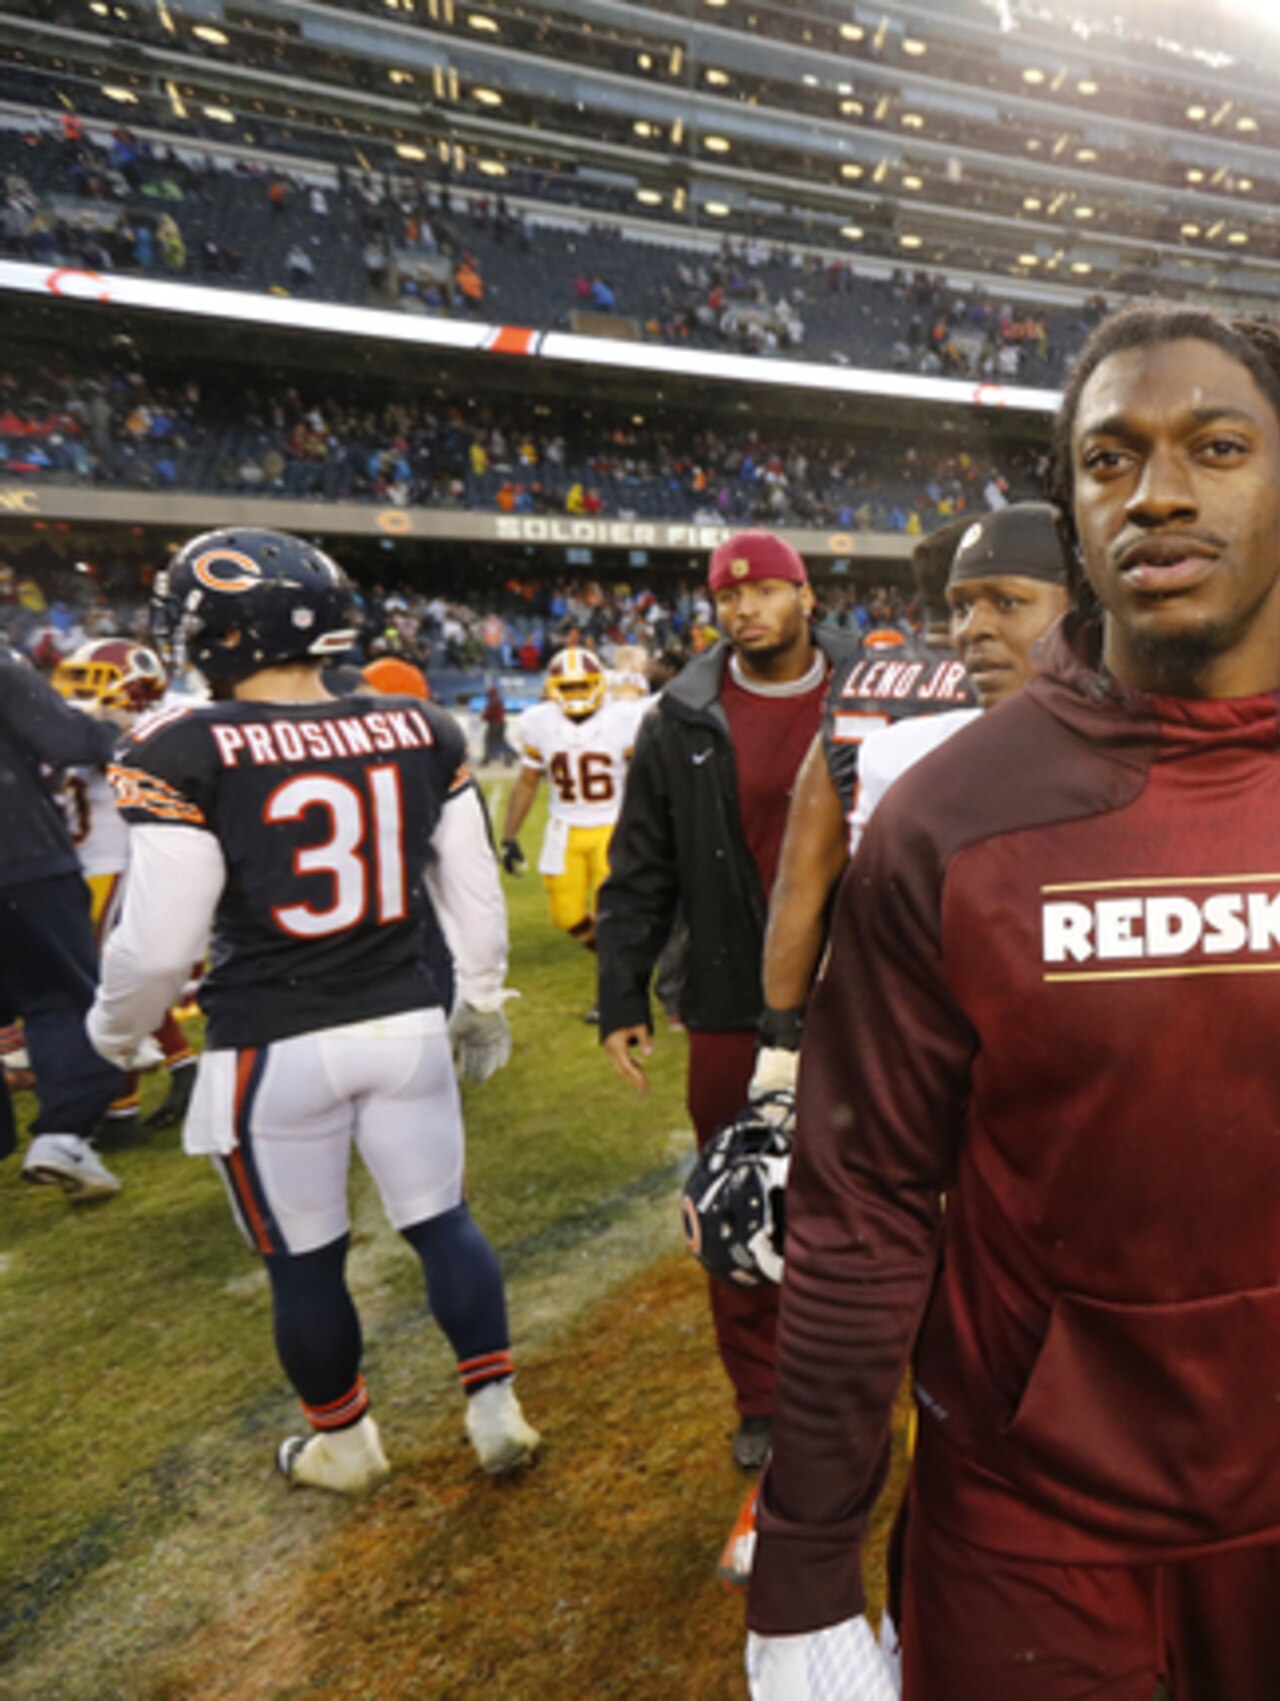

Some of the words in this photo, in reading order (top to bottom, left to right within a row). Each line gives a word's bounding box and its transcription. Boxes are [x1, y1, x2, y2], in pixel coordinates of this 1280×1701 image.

[496, 517, 655, 545] SOLDIER
[667, 525, 732, 548] FIE
[841, 659, 925, 699] LENO
[917, 659, 968, 700] JR.
[210, 708, 435, 768] PROSINSKI
[550, 750, 615, 804] 46
[262, 762, 409, 940] 31
